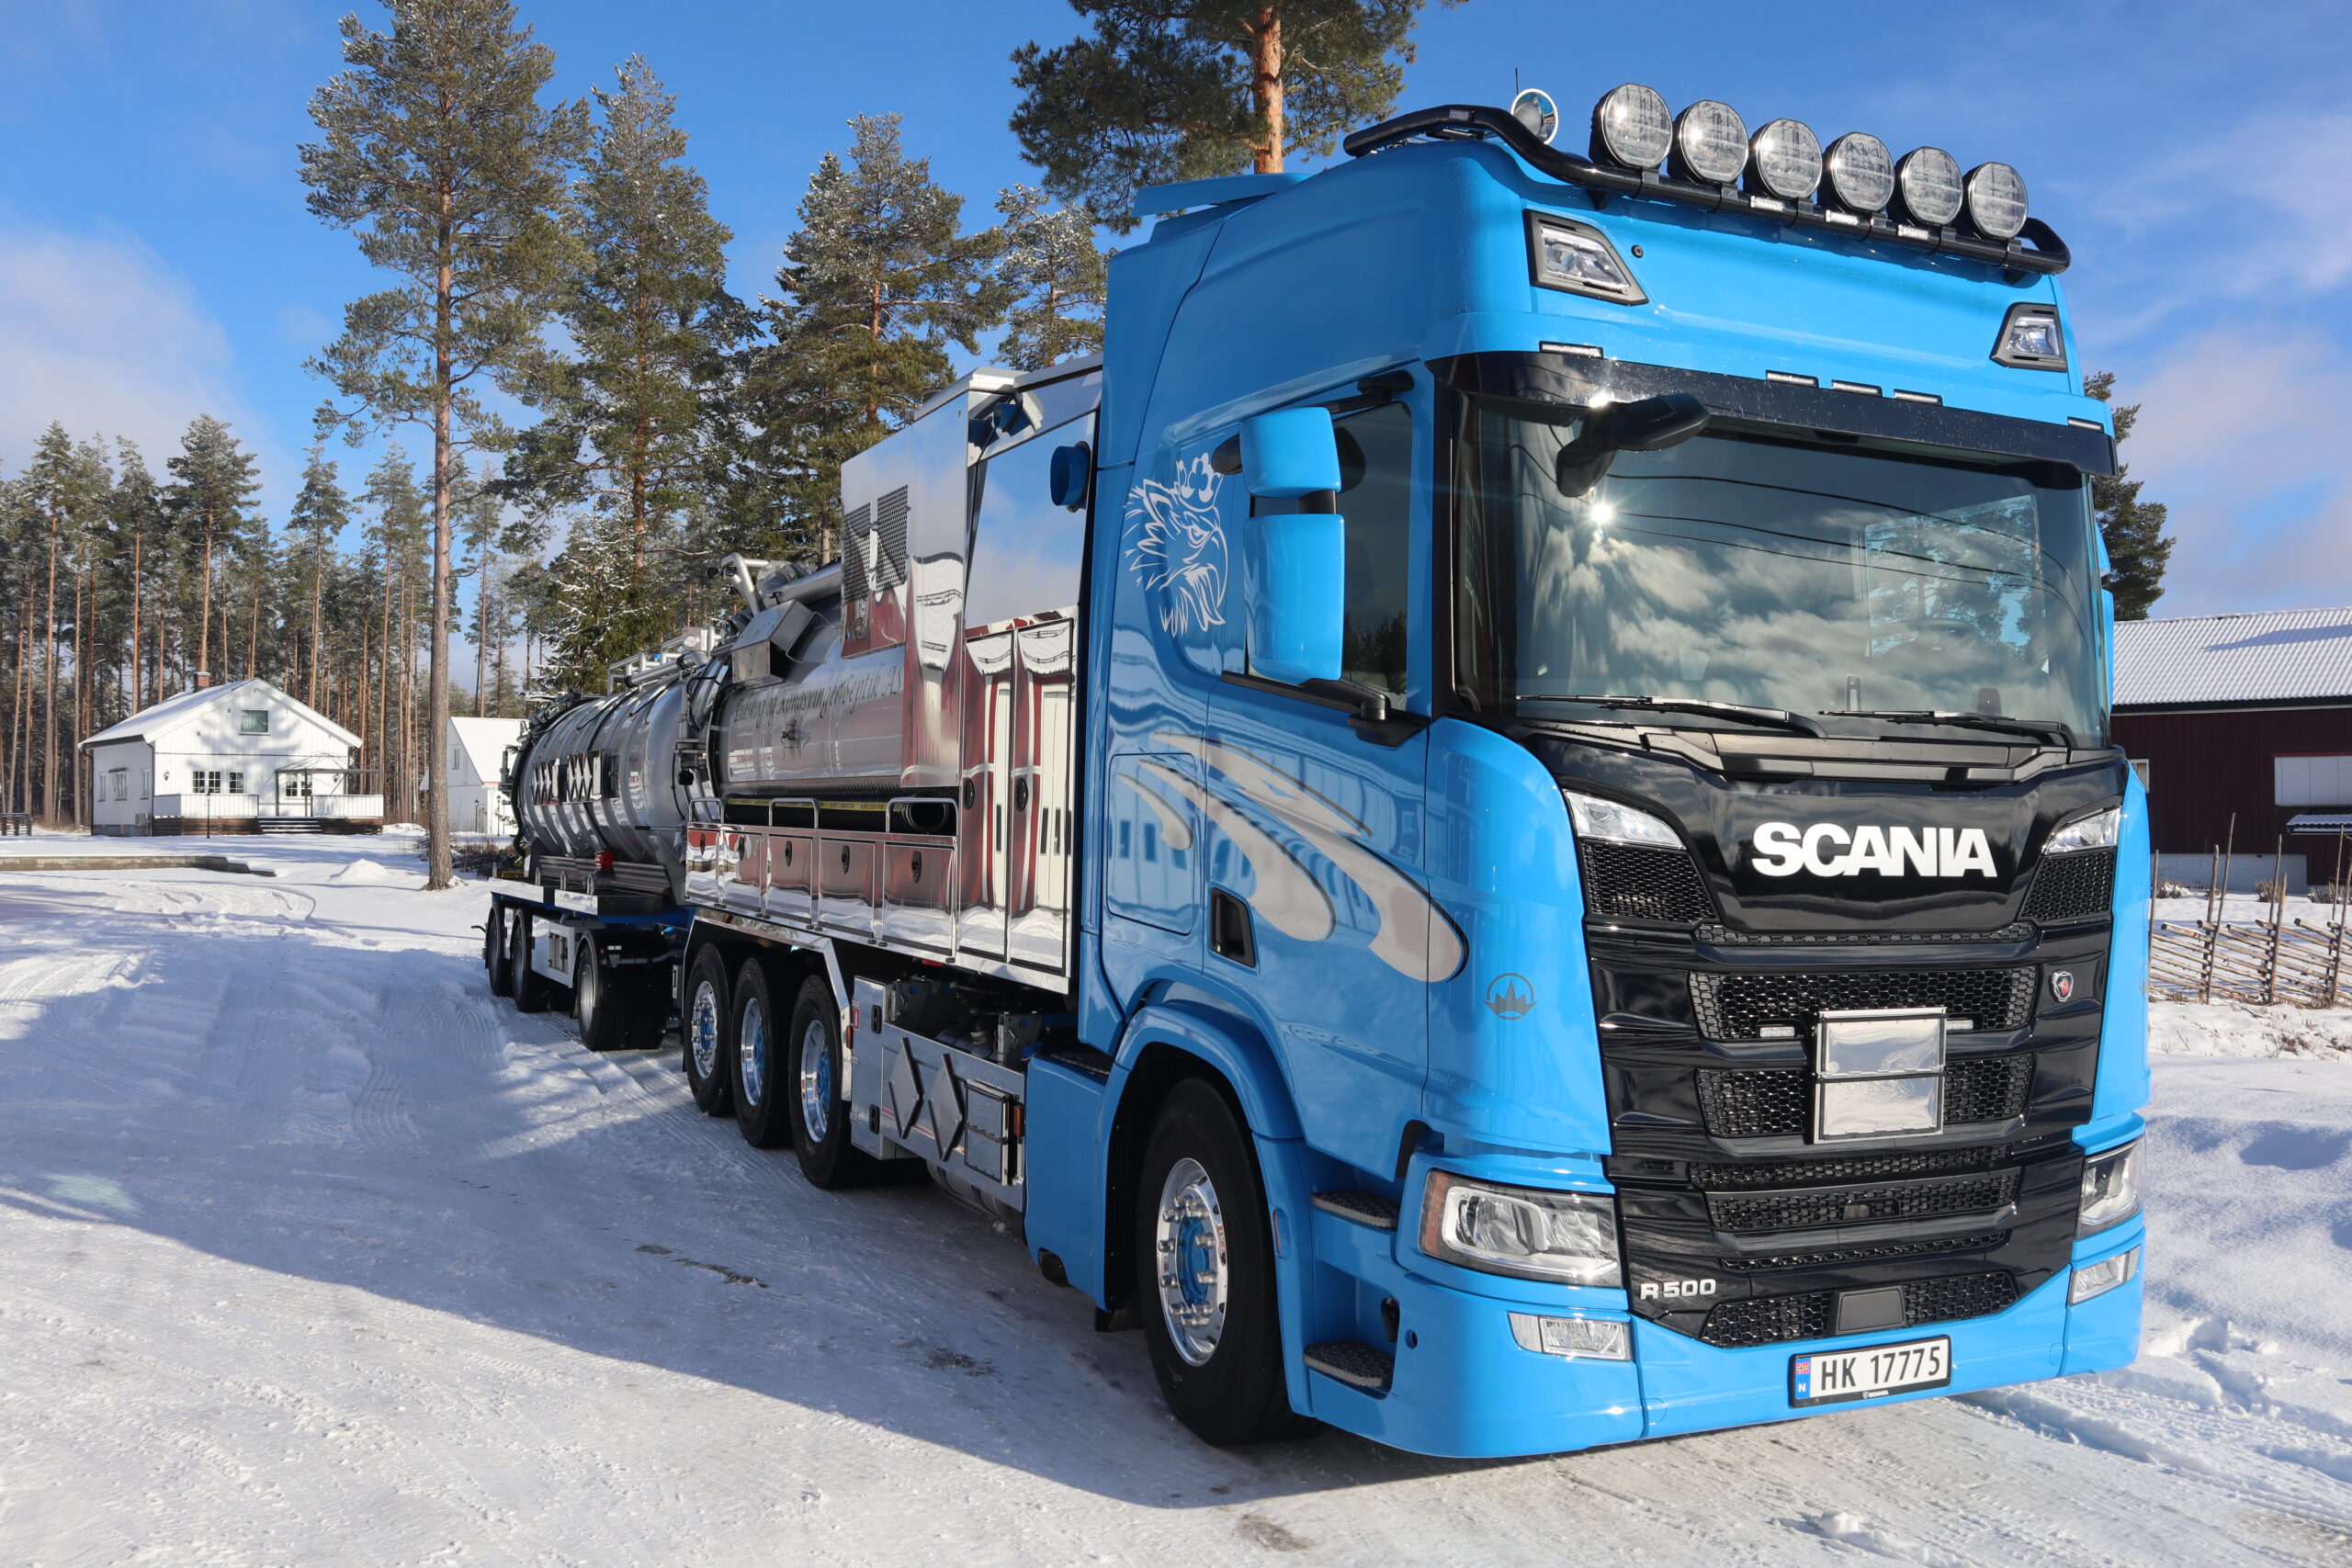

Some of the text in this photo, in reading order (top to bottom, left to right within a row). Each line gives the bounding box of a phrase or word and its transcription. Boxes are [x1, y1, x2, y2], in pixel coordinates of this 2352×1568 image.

[842, 663, 885, 715] Septik
[1751, 822, 1997, 877] SCANIA
[1640, 1279, 1716, 1300] R 500
[1798, 1382, 1806, 1393] N
[1821, 1346, 1940, 1391] HK 17775
